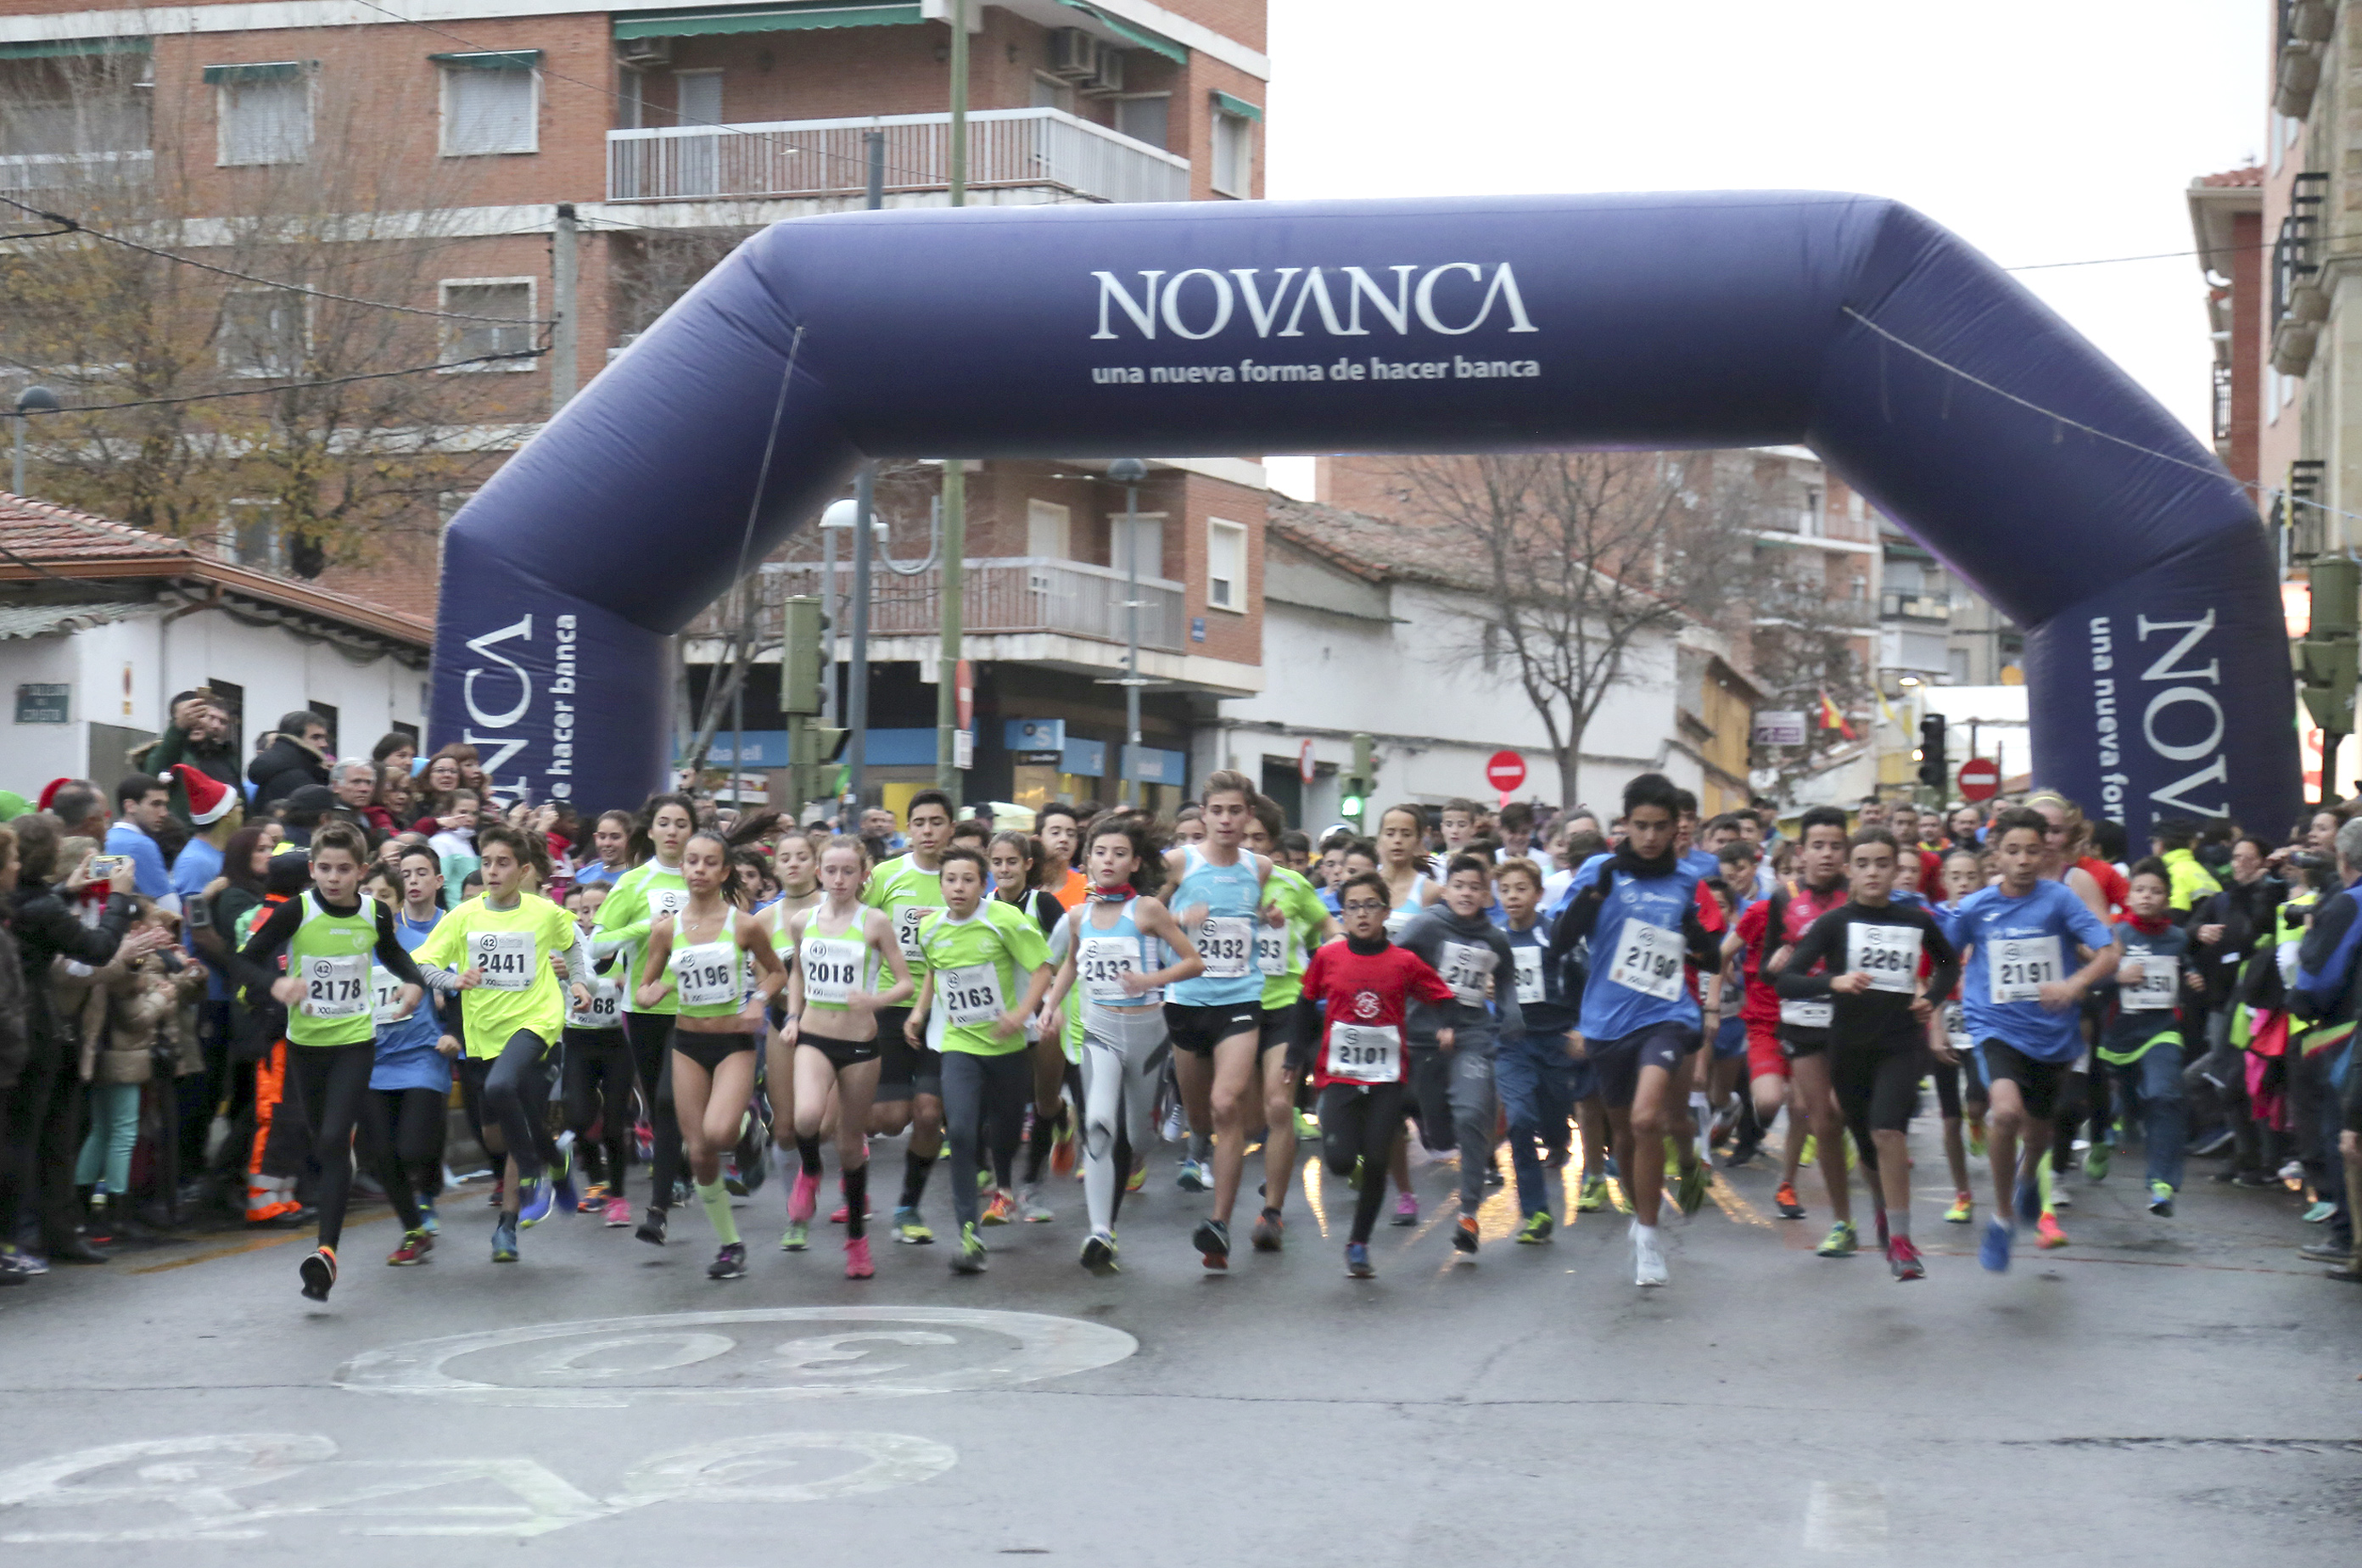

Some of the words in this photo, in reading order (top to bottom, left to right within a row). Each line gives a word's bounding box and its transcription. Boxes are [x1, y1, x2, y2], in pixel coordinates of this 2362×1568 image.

[1090, 261, 1540, 340] NOVANCA
[1091, 365, 1145, 385] una
[1150, 363, 1236, 384] nueva
[1239, 359, 1325, 383] forma
[1329, 357, 1367, 382] de
[1370, 356, 1451, 381] hacer
[1453, 354, 1542, 379] banca
[548, 614, 577, 694] banca
[2089, 616, 2114, 671] una
[2094, 678, 2121, 767] nueva
[2137, 608, 2230, 822] NOV
[546, 700, 575, 776] hacer
[483, 938, 495, 948] 42
[1198, 938, 1245, 960] 2432
[1259, 938, 1281, 960] 93
[316, 965, 330, 974] 42
[478, 953, 525, 974] 2441
[809, 960, 854, 984] 2018
[1625, 945, 1677, 980] 2190
[2000, 960, 2051, 985] 2191
[311, 977, 361, 1001] 2178
[679, 964, 730, 989] 2196
[947, 986, 994, 1011] 2163
[1339, 1045, 1388, 1065] 2101
